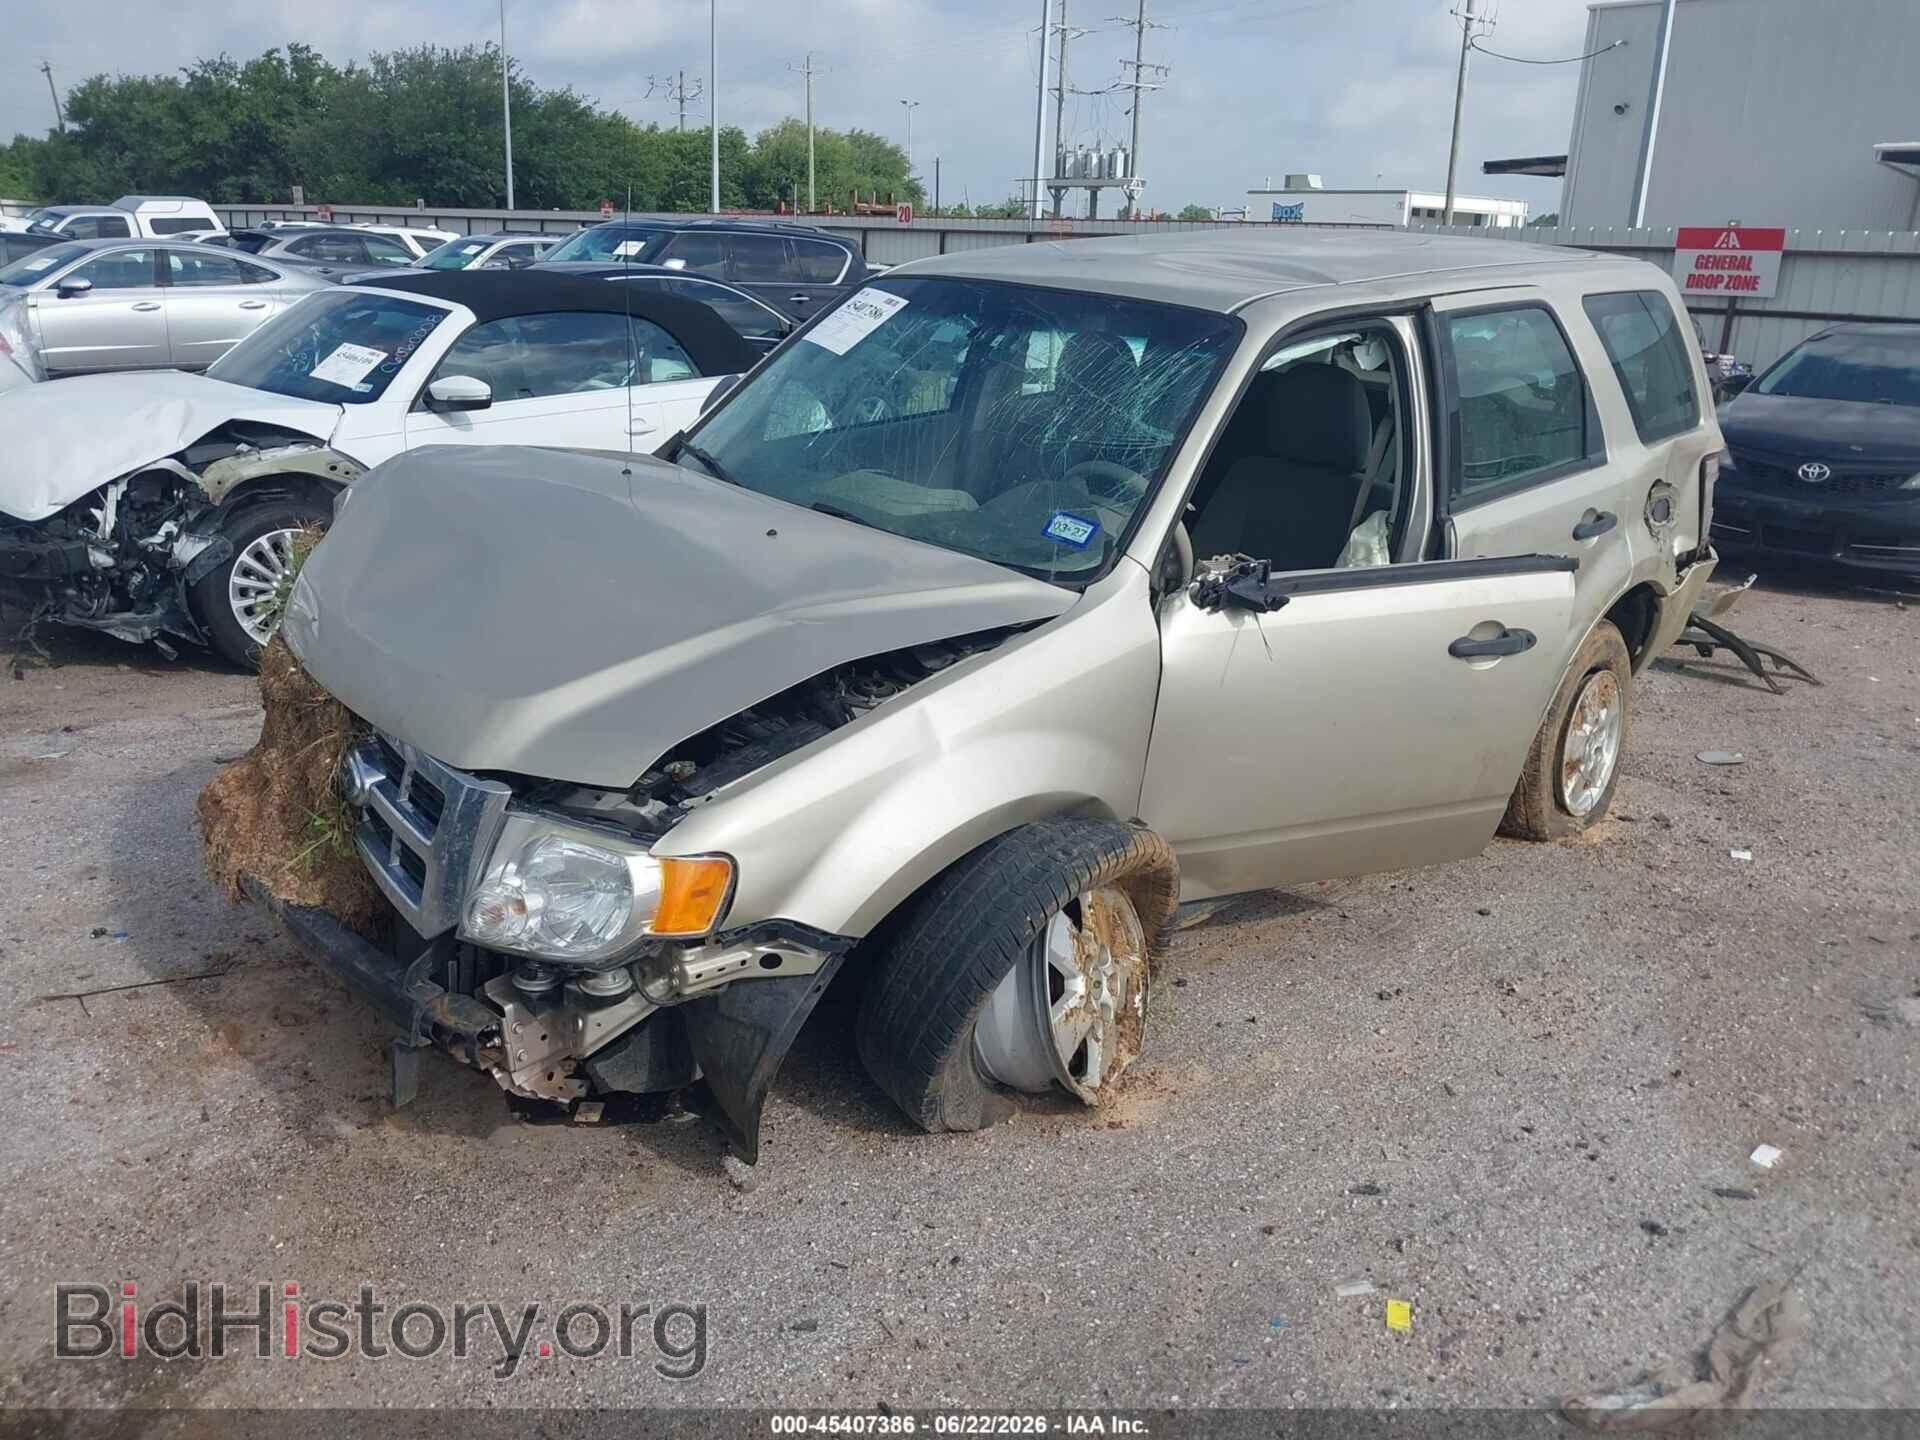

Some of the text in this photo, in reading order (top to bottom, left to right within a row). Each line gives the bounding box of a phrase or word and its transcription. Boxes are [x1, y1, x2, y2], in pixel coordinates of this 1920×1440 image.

[899, 206, 910, 223] 20
[1695, 254, 1753, 271] GENERAL
[1686, 274, 1761, 291] DROP ZONE
